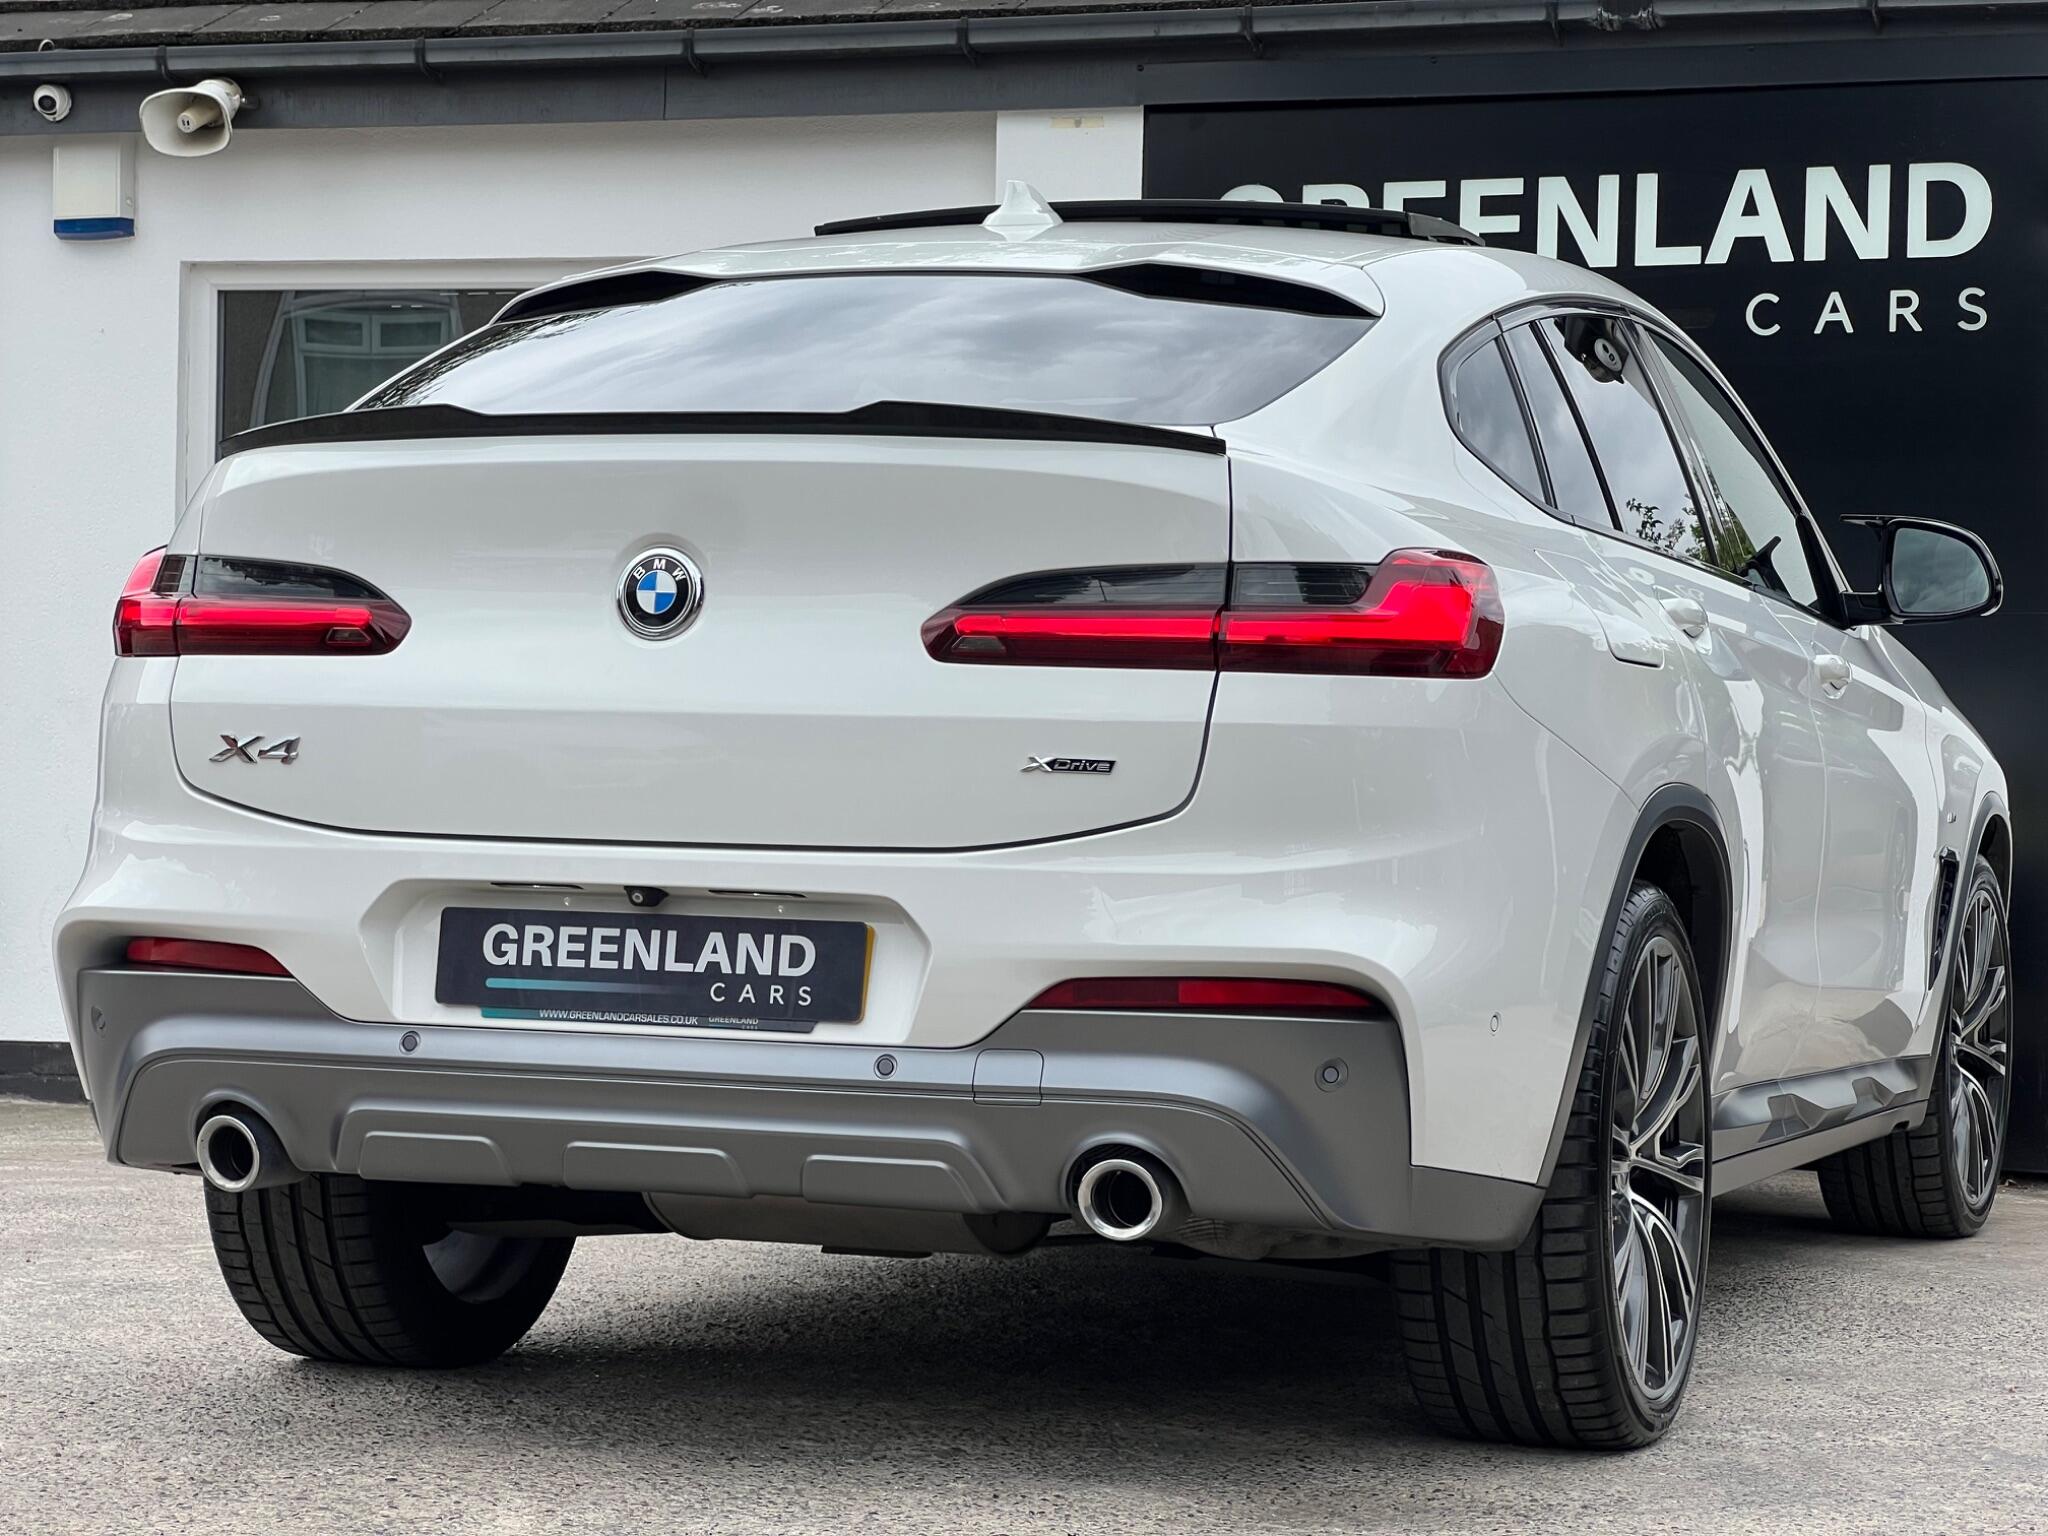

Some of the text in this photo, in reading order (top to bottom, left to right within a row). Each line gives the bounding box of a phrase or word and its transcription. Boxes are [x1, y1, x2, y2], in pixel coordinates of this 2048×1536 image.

[1219, 162, 1993, 268] ENLAND
[1745, 287, 1988, 336] CARS
[633, 558, 687, 581] BMW
[208, 734, 301, 765] X4
[482, 923, 816, 976] GREENLAND
[711, 983, 812, 1005] CARS
[539, 1009, 699, 1025] WWW.GREENLANDCARSALES.CO.UK
